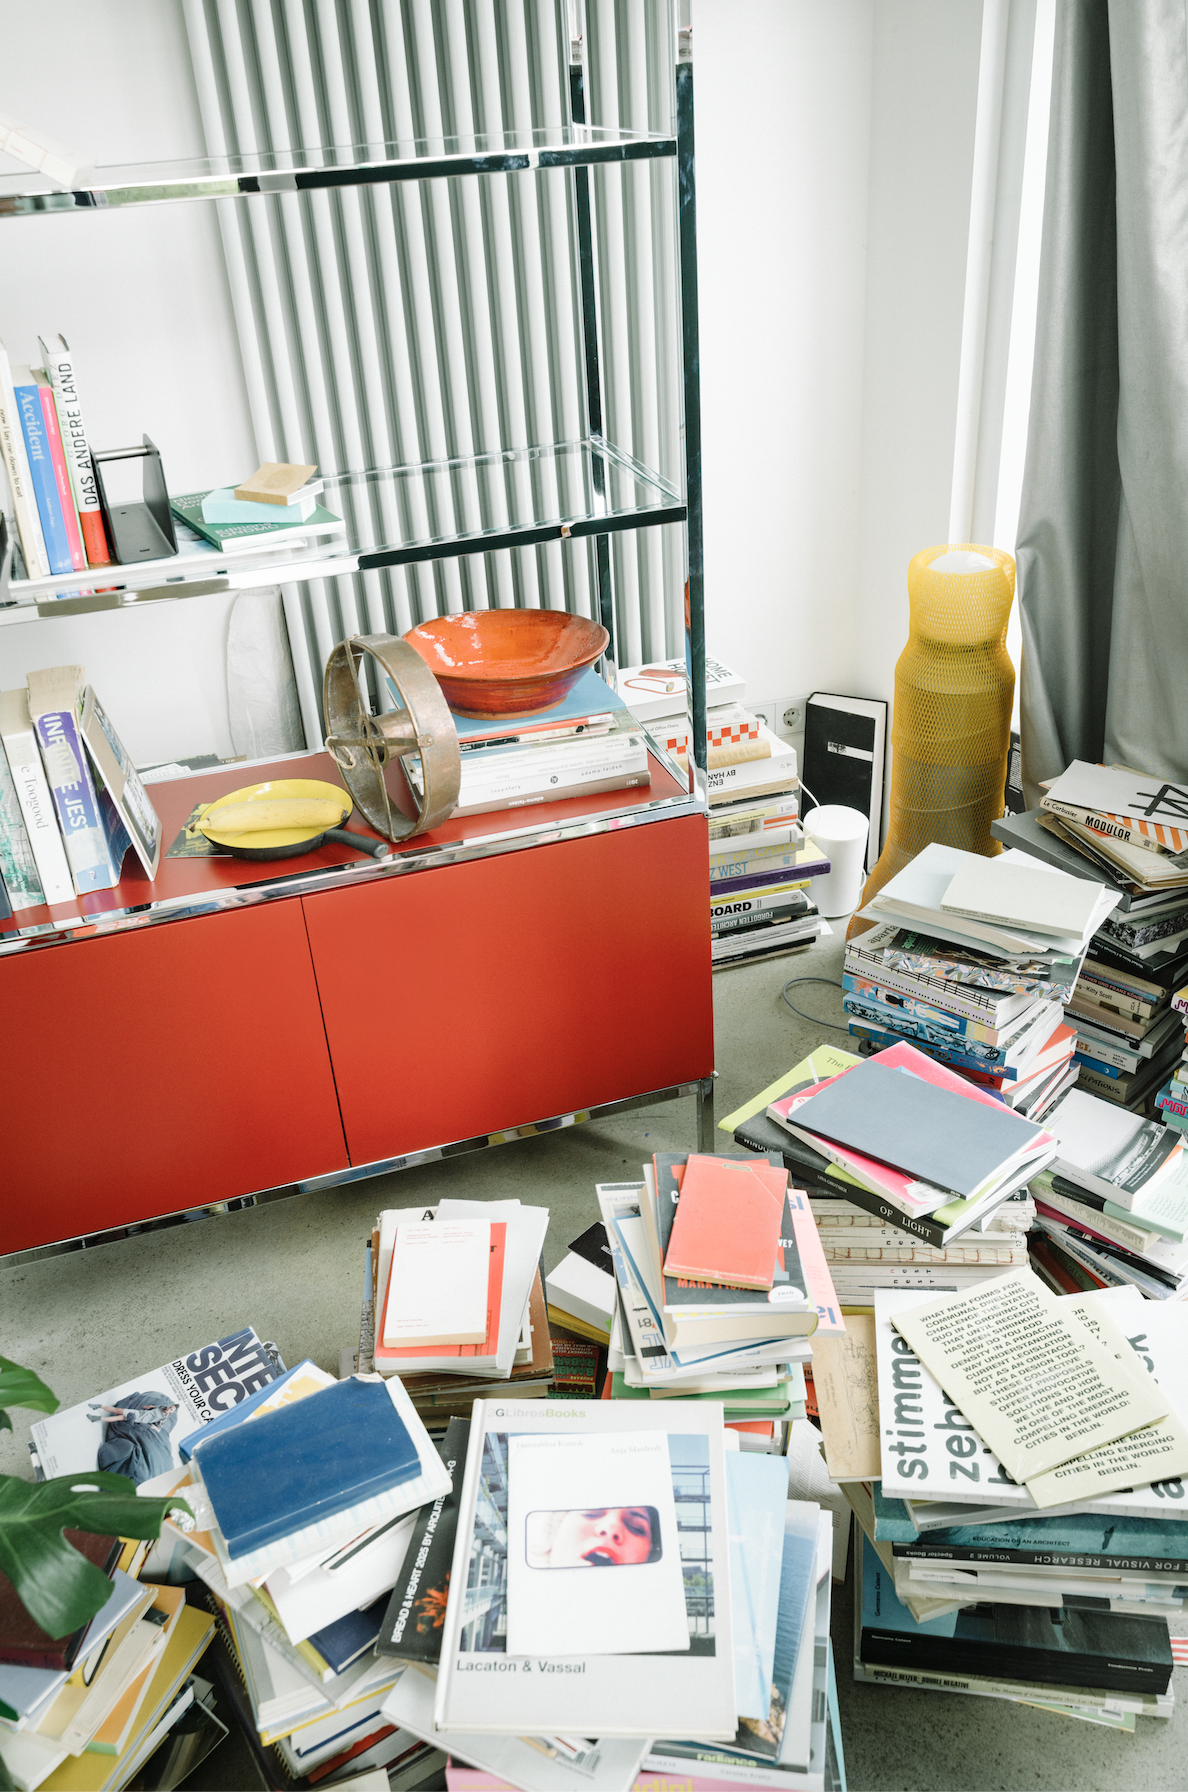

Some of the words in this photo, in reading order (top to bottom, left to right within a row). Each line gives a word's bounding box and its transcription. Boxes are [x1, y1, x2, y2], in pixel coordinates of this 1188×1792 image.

[58, 363, 78, 403] LAND
[19, 392, 45, 461] Accident
[66, 409, 91, 469] ANDERE
[9, 457, 17, 477] down
[13, 477, 19, 485] to
[15, 486, 23, 498] eat
[81, 476, 98, 505] DAS
[43, 715, 79, 794] INFINITE
[726, 769, 737, 778] BY
[24, 775, 49, 830] Toogood
[1043, 799, 1051, 807] Le
[1051, 802, 1078, 818] Corbusier
[1085, 815, 1132, 842] MODULOR
[733, 850, 748, 861] of
[755, 842, 797, 857] Chairs
[718, 861, 749, 878] WEST
[739, 911, 774, 925] FORGOTTEN
[1099, 990, 1113, 1000] Scott
[826, 1056, 844, 1069] The
[879, 1205, 894, 1218] OF
[901, 1216, 932, 1238] LIGHT
[1072, 1271, 1087, 1286] Life
[920, 1310, 945, 1323] WHAT
[947, 1301, 968, 1313] NEW
[968, 1288, 1001, 1305] FORMS
[1001, 1280, 1022, 1292] FOR
[925, 1305, 979, 1329] COMMUNAL
[979, 1286, 1026, 1307] DWELLING
[925, 1311, 981, 1337] CHALLENGE
[980, 1303, 1001, 1315] THE
[1000, 1290, 1036, 1307] STATUS
[931, 1331, 953, 1343] QUO
[954, 1326, 966, 1335] IN
[974, 1305, 1019, 1326] GROWING
[1019, 1296, 1040, 1308] CITY
[941, 1334, 965, 1348] THAT
[966, 1323, 995, 1337] UNTIL
[994, 1303, 1041, 1326] RECENTLY
[943, 1343, 965, 1355] HAS
[965, 1332, 992, 1346] BEEN
[991, 1308, 1049, 1335] SHRINKING?
[950, 1348, 991, 1370] DENSITY
[992, 1344, 1004, 1352] IN
[1012, 1318, 1065, 1344] PROACTIVE
[961, 1342, 985, 1356] HOW
[985, 1336, 1001, 1346] DO
[1001, 1328, 1022, 1339] YOU
[1022, 1319, 1043, 1331] ADD
[962, 1360, 983, 1373] WAY
[983, 1327, 1064, 1364] UNDERSTANDING
[965, 1357, 1011, 1381] CURRENT
[1011, 1333, 1072, 1361] LEGISLATION
[972, 1373, 995, 1387] NOT
[995, 1366, 1010, 1377] AS
[1010, 1360, 1025, 1371] AN
[1025, 1339, 1076, 1364] OBSTACLE
[972, 1383, 993, 1396] BUT
[994, 1376, 1009, 1387] AS
[1009, 1372, 1018, 1380] A
[1017, 1358, 1055, 1376] DESIGN
[1055, 1344, 1086, 1361] TOOL?
[172, 1360, 192, 1385] DRESS
[186, 1384, 206, 1409] YOUR
[989, 1382, 1035, 1407] STUDENT
[1035, 1359, 1094, 1387] PROPOSALS
[990, 1379, 1024, 1397] THESE
[1023, 1355, 1082, 1382] COLLECTIVE
[998, 1394, 1031, 1412] OFFER
[1031, 1366, 1098, 1398] PROVOCATIVE
[885, 1321, 930, 1480] stimme
[1005, 1390, 1063, 1419] SOLUTIONS
[1062, 1384, 1077, 1394] TO
[1077, 1374, 1101, 1388] HOW
[1013, 1413, 1031, 1425] WE
[1030, 1403, 1053, 1417] LIVE
[1053, 1394, 1075, 1408] AND
[1075, 1381, 1106, 1398] WORK
[1015, 1425, 1028, 1435] IN
[1028, 1414, 1051, 1428] ONE
[1051, 1408, 1066, 1418] OF
[1065, 1398, 1087, 1412] THE
[1086, 1386, 1115, 1403] MOST
[1013, 1412, 1078, 1445] COMPELLING
[1078, 1390, 1130, 1416] EMERGING
[1025, 1430, 1059, 1450] CITIES
[1058, 1425, 1071, 1434] IN
[1070, 1415, 1092, 1428] THE
[1092, 1400, 1131, 1419] WORLD:
[1064, 1421, 1105, 1441] BERLIN.
[1117, 1434, 1176, 1450] EMERGING
[1128, 1429, 1161, 1442] MOST
[609, 1447, 628, 1456] Anja
[629, 1444, 662, 1454] Manfredi
[1054, 1464, 1091, 1479] CITIES
[1106, 1454, 1130, 1465] THE
[1130, 1445, 1175, 1460] WORLD:
[1097, 1463, 1142, 1477] BERLIN.
[423, 1532, 433, 1548] BY
[905, 1550, 926, 1558] Books
[972, 1536, 1011, 1544] EDUCATION
[1032, 1539, 1071, 1547] ARCHITECT
[415, 1547, 430, 1568] 2025
[926, 1551, 954, 1559] Spector
[976, 1553, 1011, 1561] VOLUME
[1034, 1555, 1101, 1566] RESEARCH
[1105, 1558, 1150, 1569] VISUAL
[1154, 1561, 1180, 1571] FOR
[405, 1565, 423, 1598] HEART
[874, 1572, 882, 1590] Celant
[404, 1597, 414, 1612] &
[874, 1590, 882, 1617] Germano
[391, 1613, 410, 1643] BREAD
[456, 1659, 517, 1673] Lacaton
[522, 1659, 533, 1673] &
[538, 1660, 586, 1674] Vassal
[873, 1669, 899, 1680] MICHAEL
[921, 1676, 943, 1686] DOUBLE
[943, 1678, 970, 1690] NEGATIVE
[696, 1752, 758, 1768] radiance
